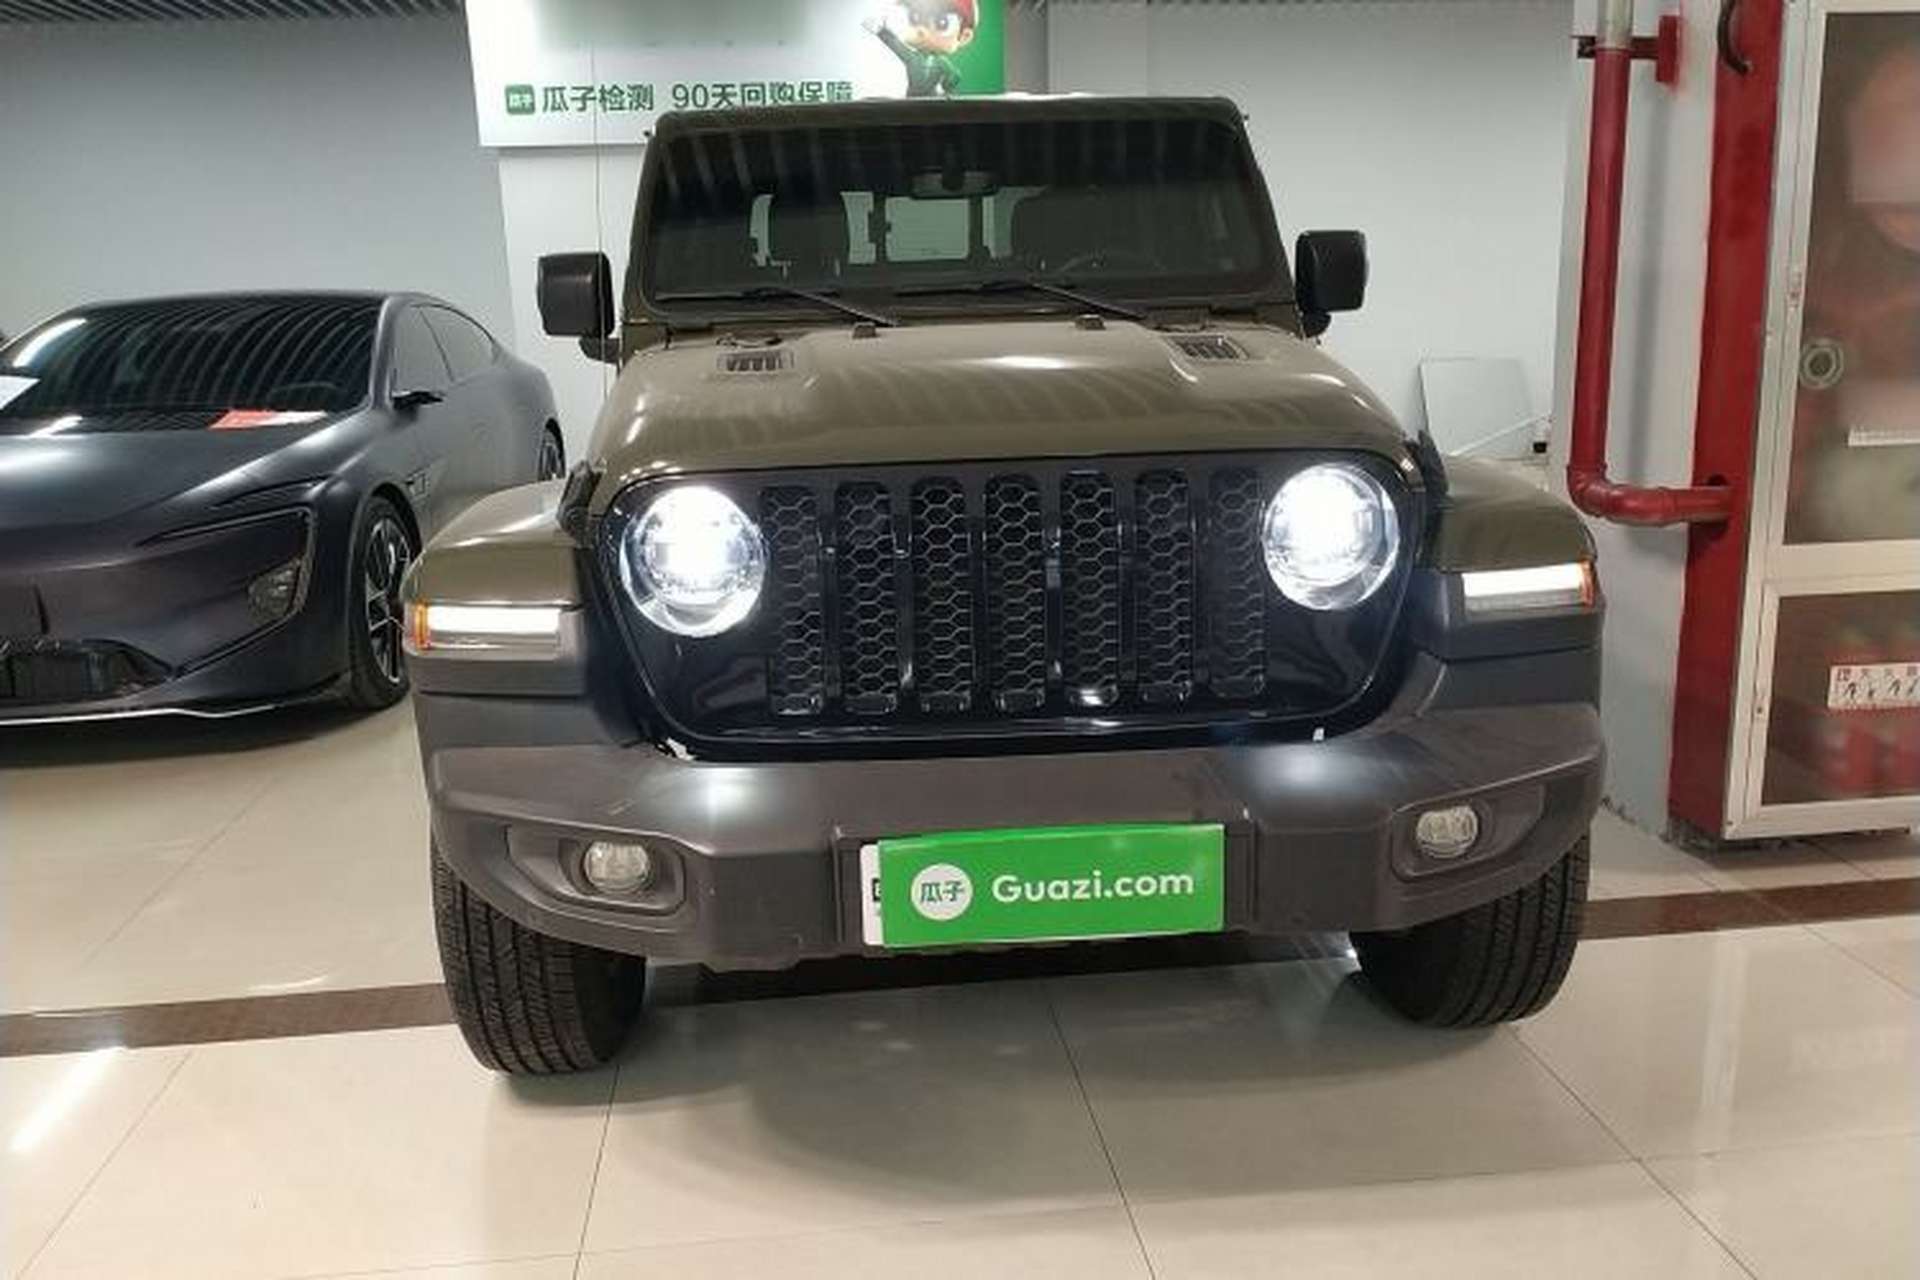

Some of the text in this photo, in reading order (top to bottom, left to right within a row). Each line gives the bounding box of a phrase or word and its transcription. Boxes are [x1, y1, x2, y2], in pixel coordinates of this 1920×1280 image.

[542, 84, 654, 112] 瓜子检测
[920, 880, 965, 903] 瓜子
[992, 870, 1194, 903] Guazi.com
